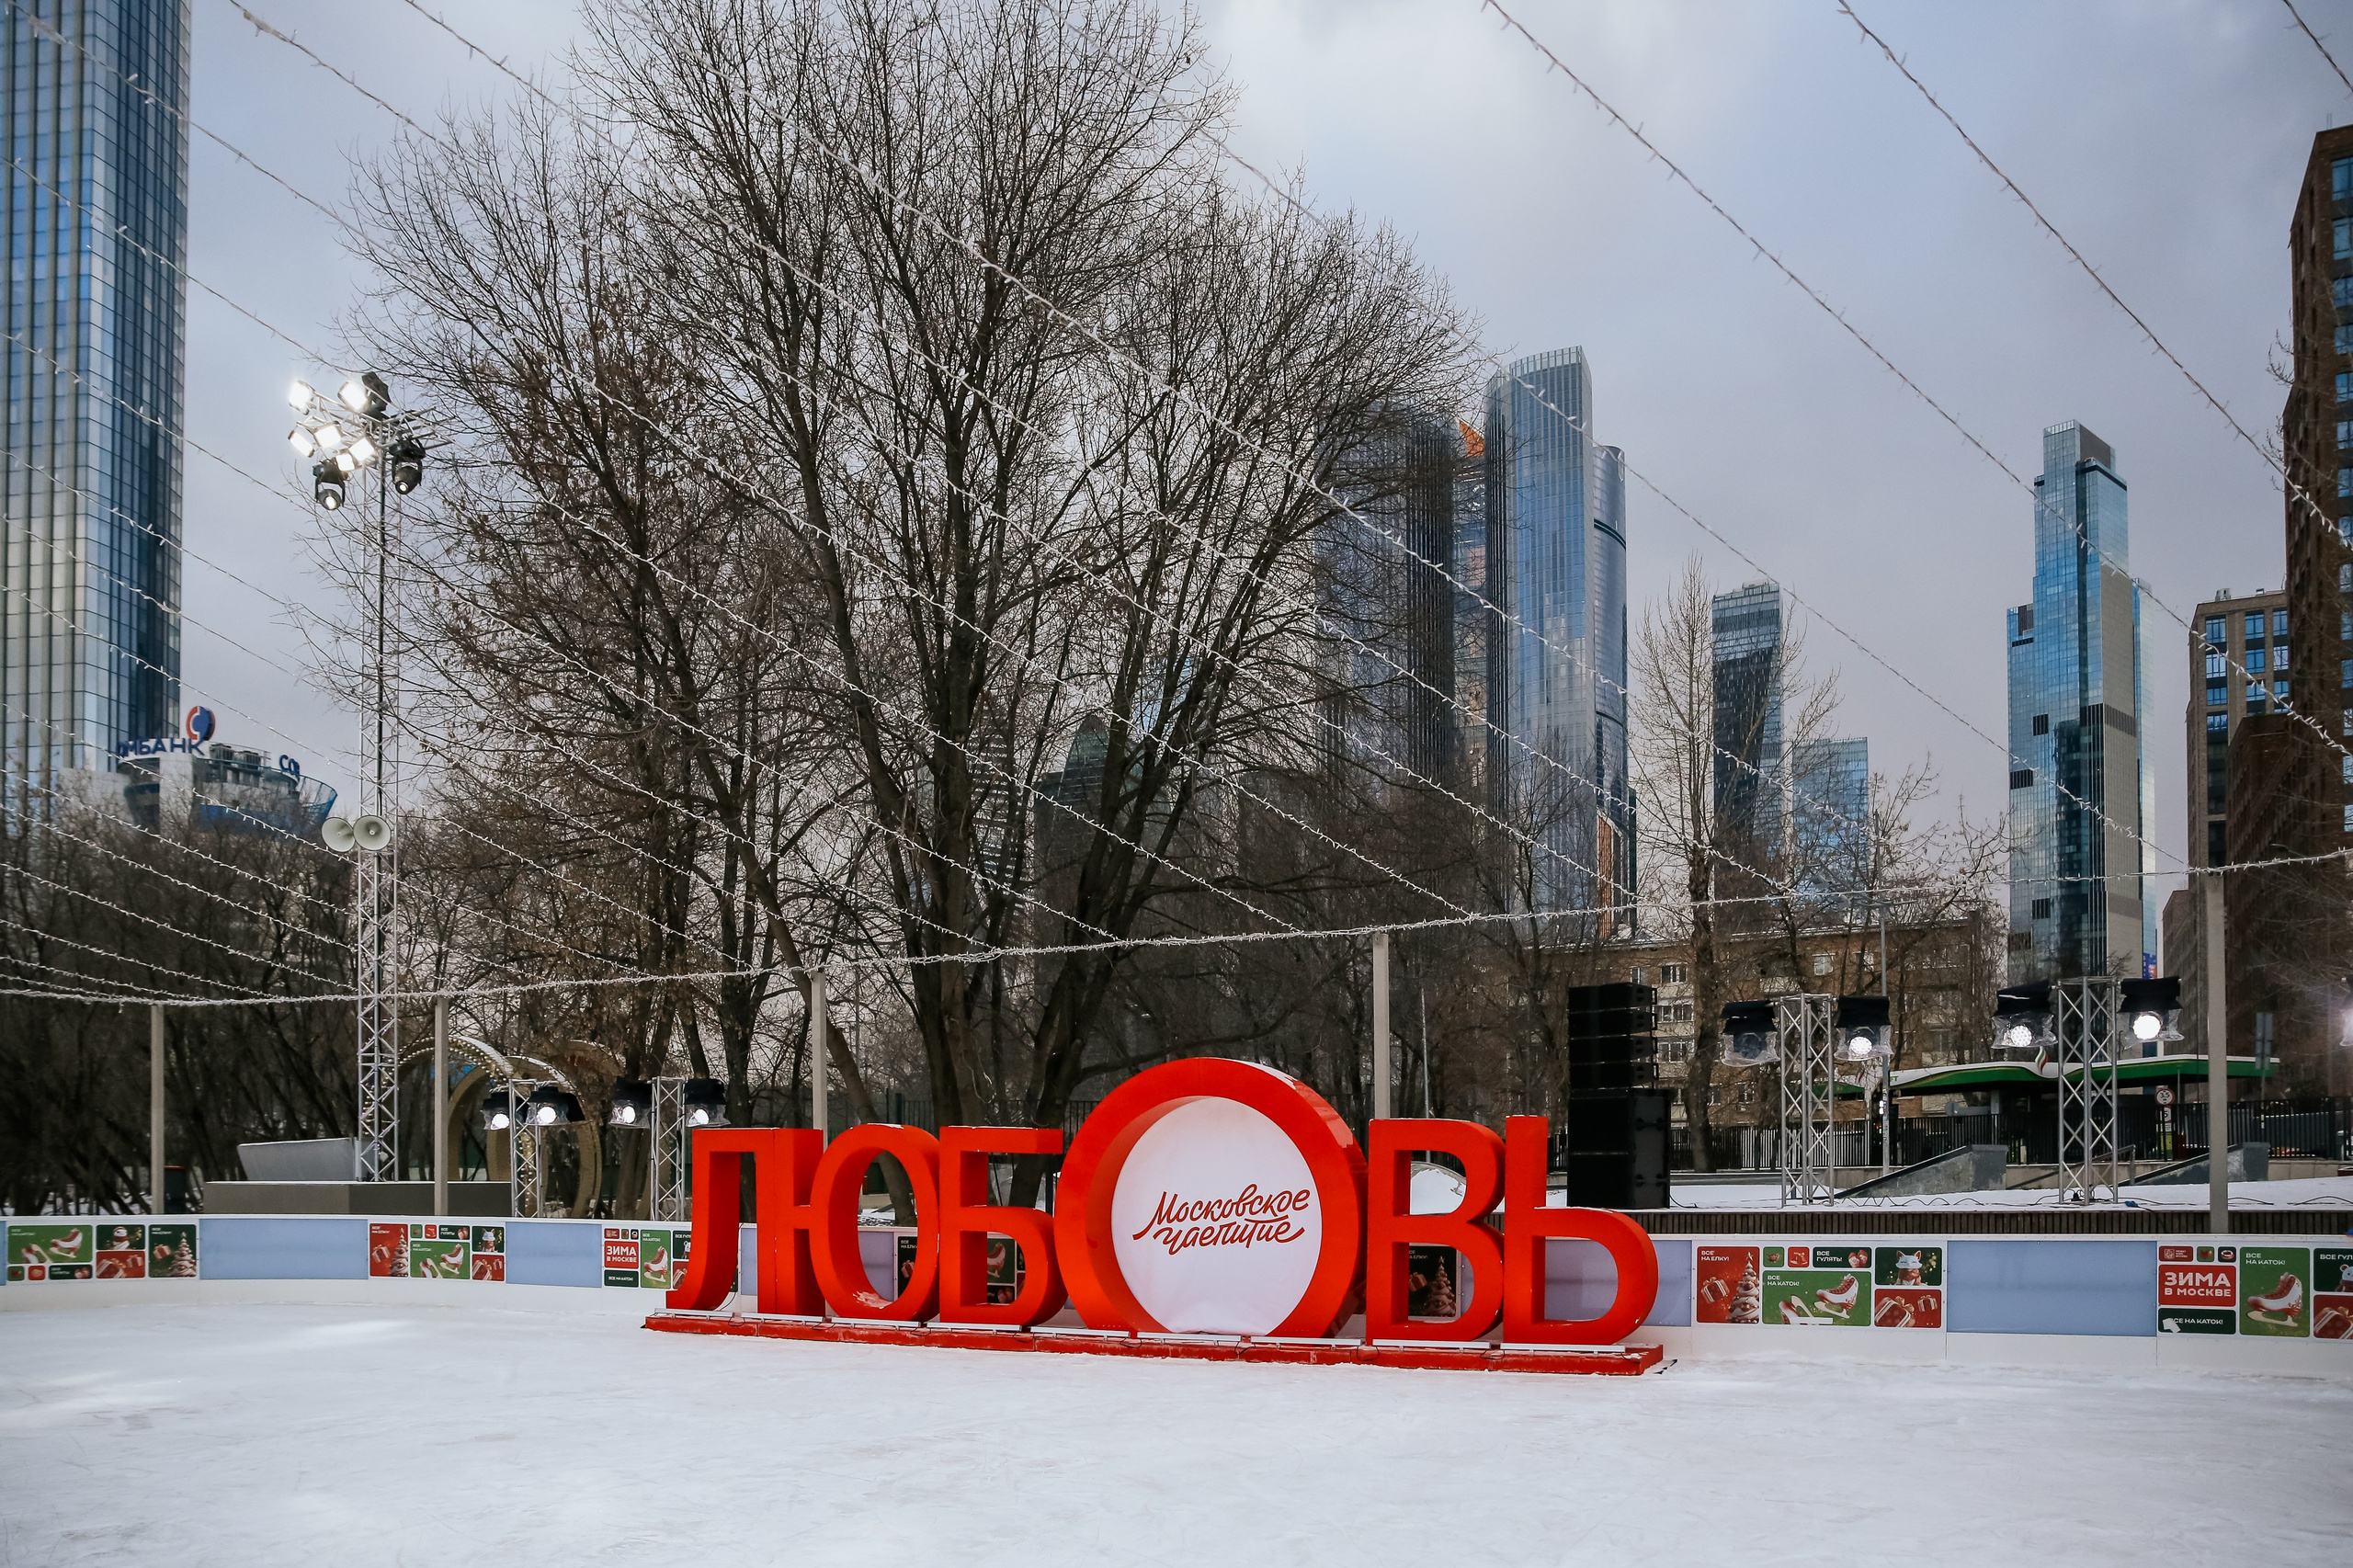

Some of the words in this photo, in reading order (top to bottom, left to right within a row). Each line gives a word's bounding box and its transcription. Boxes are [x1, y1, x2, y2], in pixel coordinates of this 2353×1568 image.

[666, 1057, 1659, 1346] ЛЮБОВЬ
[1132, 1184, 1311, 1241] Московское
[607, 1245, 637, 1256] ЗИМА
[2164, 1271, 2232, 1288] ЗИМА
[2164, 1288, 2173, 1296] В
[2177, 1288, 2232, 1297] МОСКВЕ
